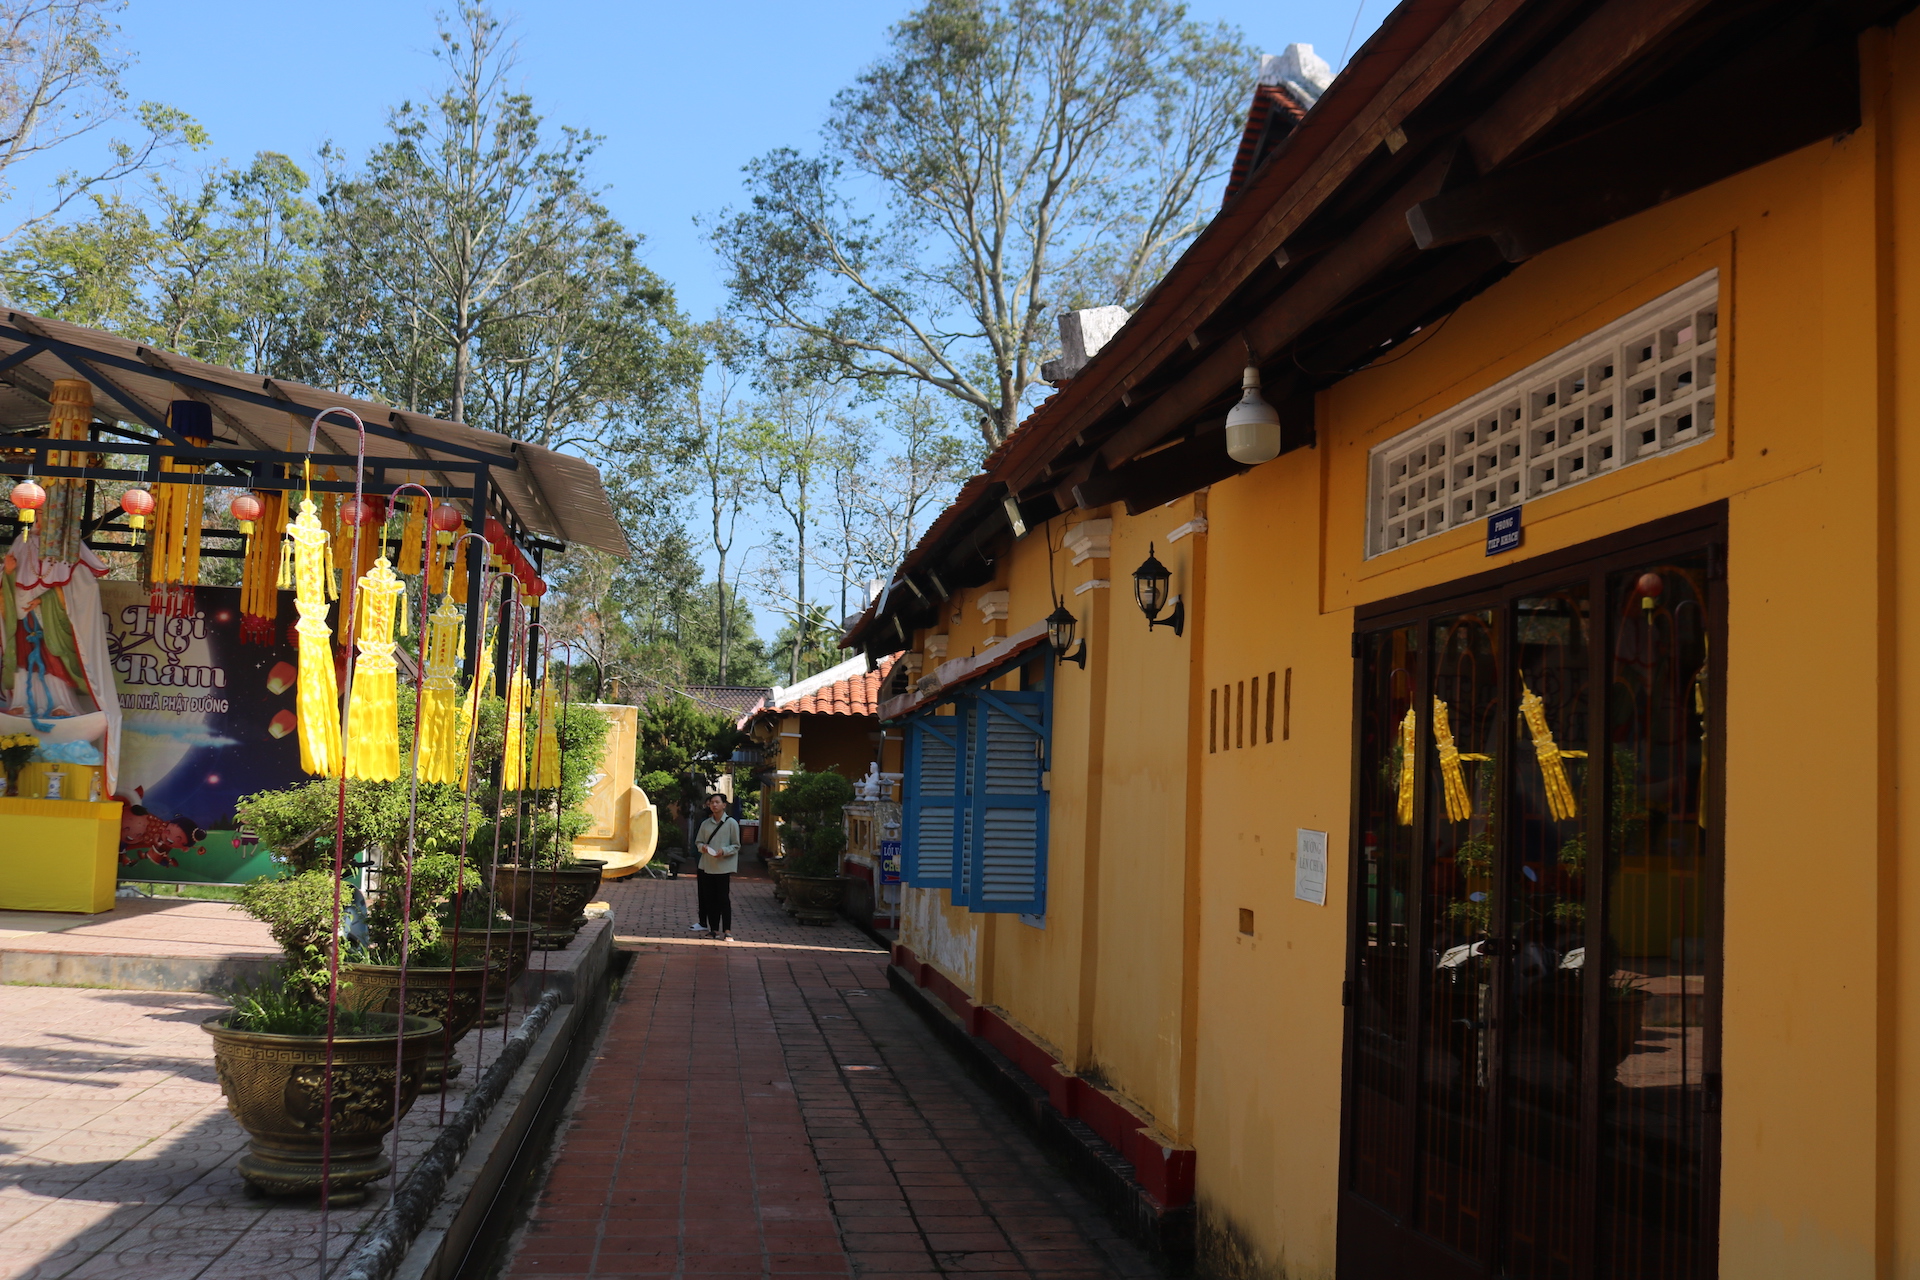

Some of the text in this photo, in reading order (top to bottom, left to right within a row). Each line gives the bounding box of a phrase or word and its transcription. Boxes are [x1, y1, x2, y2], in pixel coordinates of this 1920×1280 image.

[117, 692, 229, 715] AM NHÃ PHẬT ĐƯỜNG
